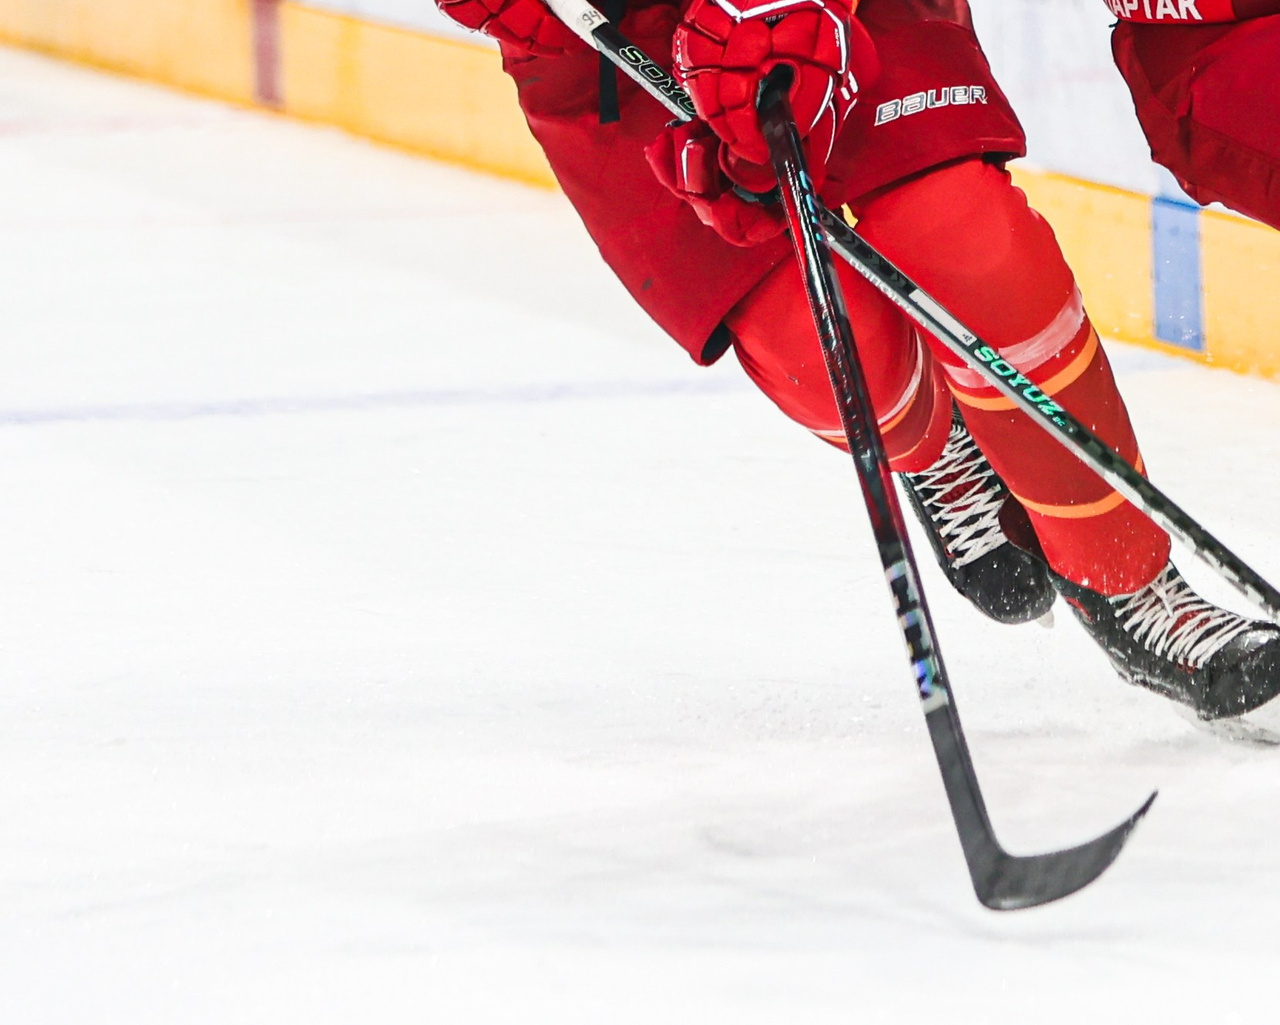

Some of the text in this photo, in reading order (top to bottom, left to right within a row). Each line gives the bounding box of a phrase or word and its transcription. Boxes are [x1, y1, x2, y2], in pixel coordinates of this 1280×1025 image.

[581, 10, 602, 26] 94
[618, 45, 698, 116] SOYU
[873, 84, 989, 127] BAUER
[973, 345, 1065, 416] SOYUZ
